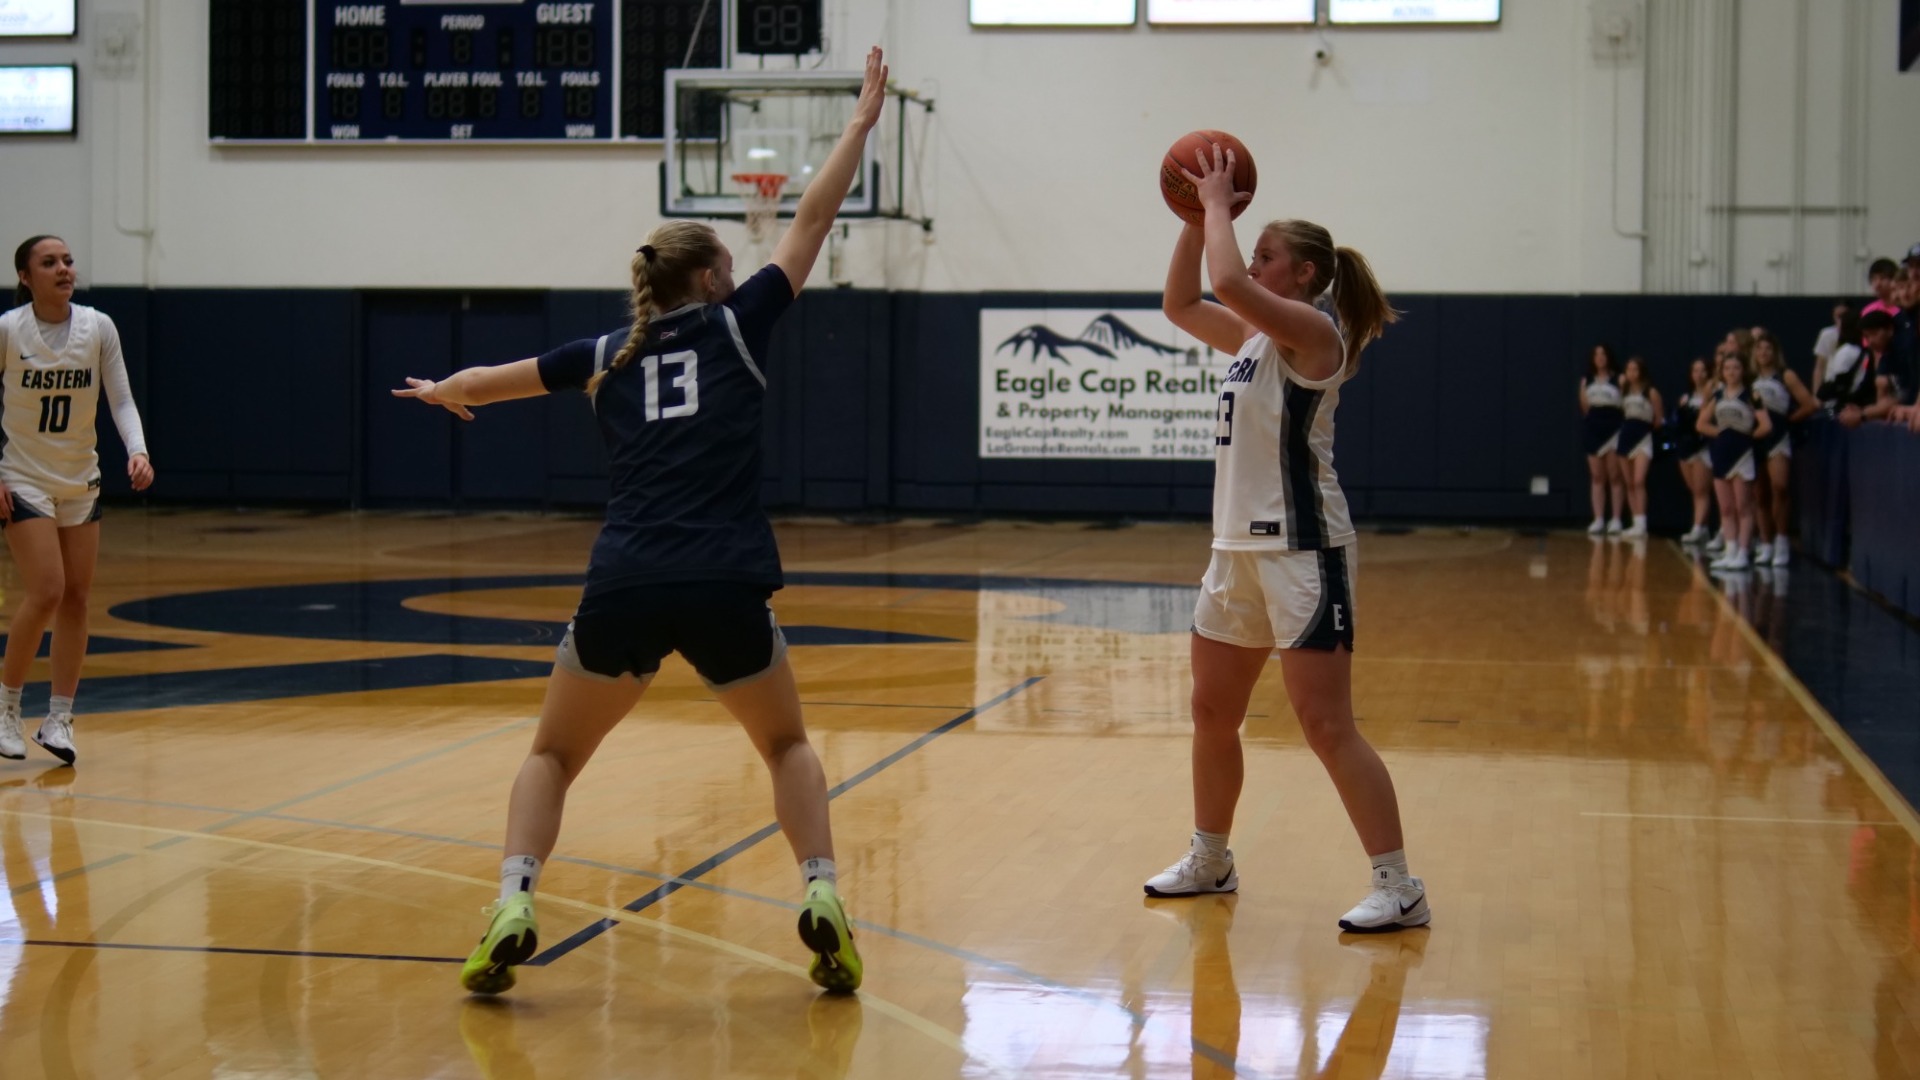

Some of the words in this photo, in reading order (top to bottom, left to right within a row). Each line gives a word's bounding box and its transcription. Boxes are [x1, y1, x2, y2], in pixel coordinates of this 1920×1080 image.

[335, 5, 386, 26] HOME
[536, 3, 595, 24] GUEST
[441, 14, 485, 30] PERIOD
[326, 72, 365, 88] FOULS
[424, 72, 469, 87] PLAYER
[472, 72, 503, 87] FOUL
[561, 71, 600, 87] FOULS
[331, 124, 360, 139] WON
[450, 124, 473, 139] SET
[565, 124, 595, 139] WON
[21, 367, 92, 389] EASTERN
[640, 349, 699, 422] 13
[996, 369, 1071, 399] Eagle
[1079, 369, 1136, 399] Cap
[38, 395, 71, 433] 10
[997, 403, 1010, 418] &
[1019, 402, 1099, 422] Property
[1108, 403, 1217, 424] Manageme
[985, 426, 1128, 441] EagleCapRealty.com
[1153, 427, 1215, 440] 541-963-
[987, 443, 1141, 454] LaGrandeRentals.com
[1151, 443, 1215, 455] 541-963-
[1332, 603, 1345, 631] E
